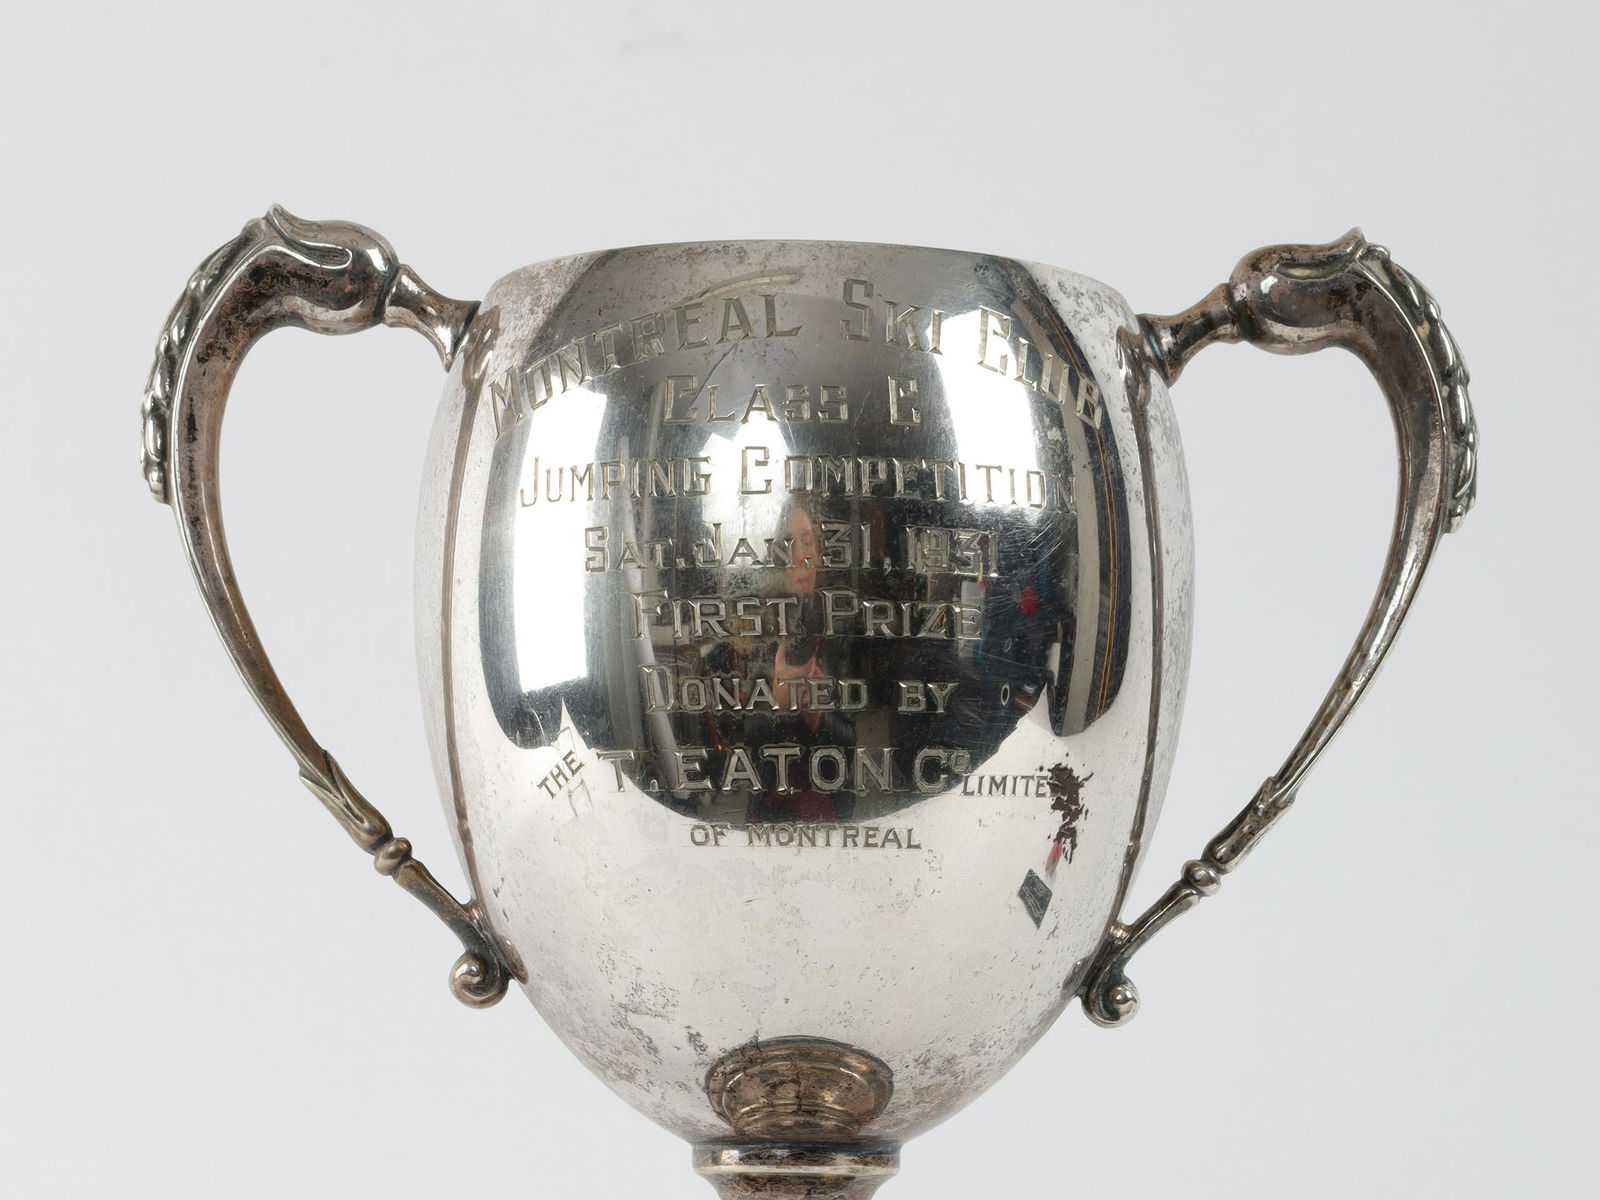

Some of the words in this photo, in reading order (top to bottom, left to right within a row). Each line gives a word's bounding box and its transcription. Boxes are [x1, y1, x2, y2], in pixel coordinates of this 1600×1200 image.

[489, 294, 803, 440] MONTREAL
[840, 278, 943, 355] SKI
[978, 304, 1103, 430] CLUB
[663, 374, 849, 424] CLASS
[520, 456, 712, 507] JUMPING
[741, 445, 1079, 517] COMPETITION
[904, 526, 999, 578] 1931
[630, 588, 799, 640] FIRST
[821, 588, 984, 640] PRIZE
[641, 663, 868, 713] DONATED
[898, 679, 959, 713] BY
[536, 749, 585, 800] THE
[596, 749, 658, 793] T.
[673, 746, 894, 795] EATON
[961, 773, 1064, 798] LIMITE
[690, 823, 732, 847] OF
[746, 823, 922, 850] MONTREAL
